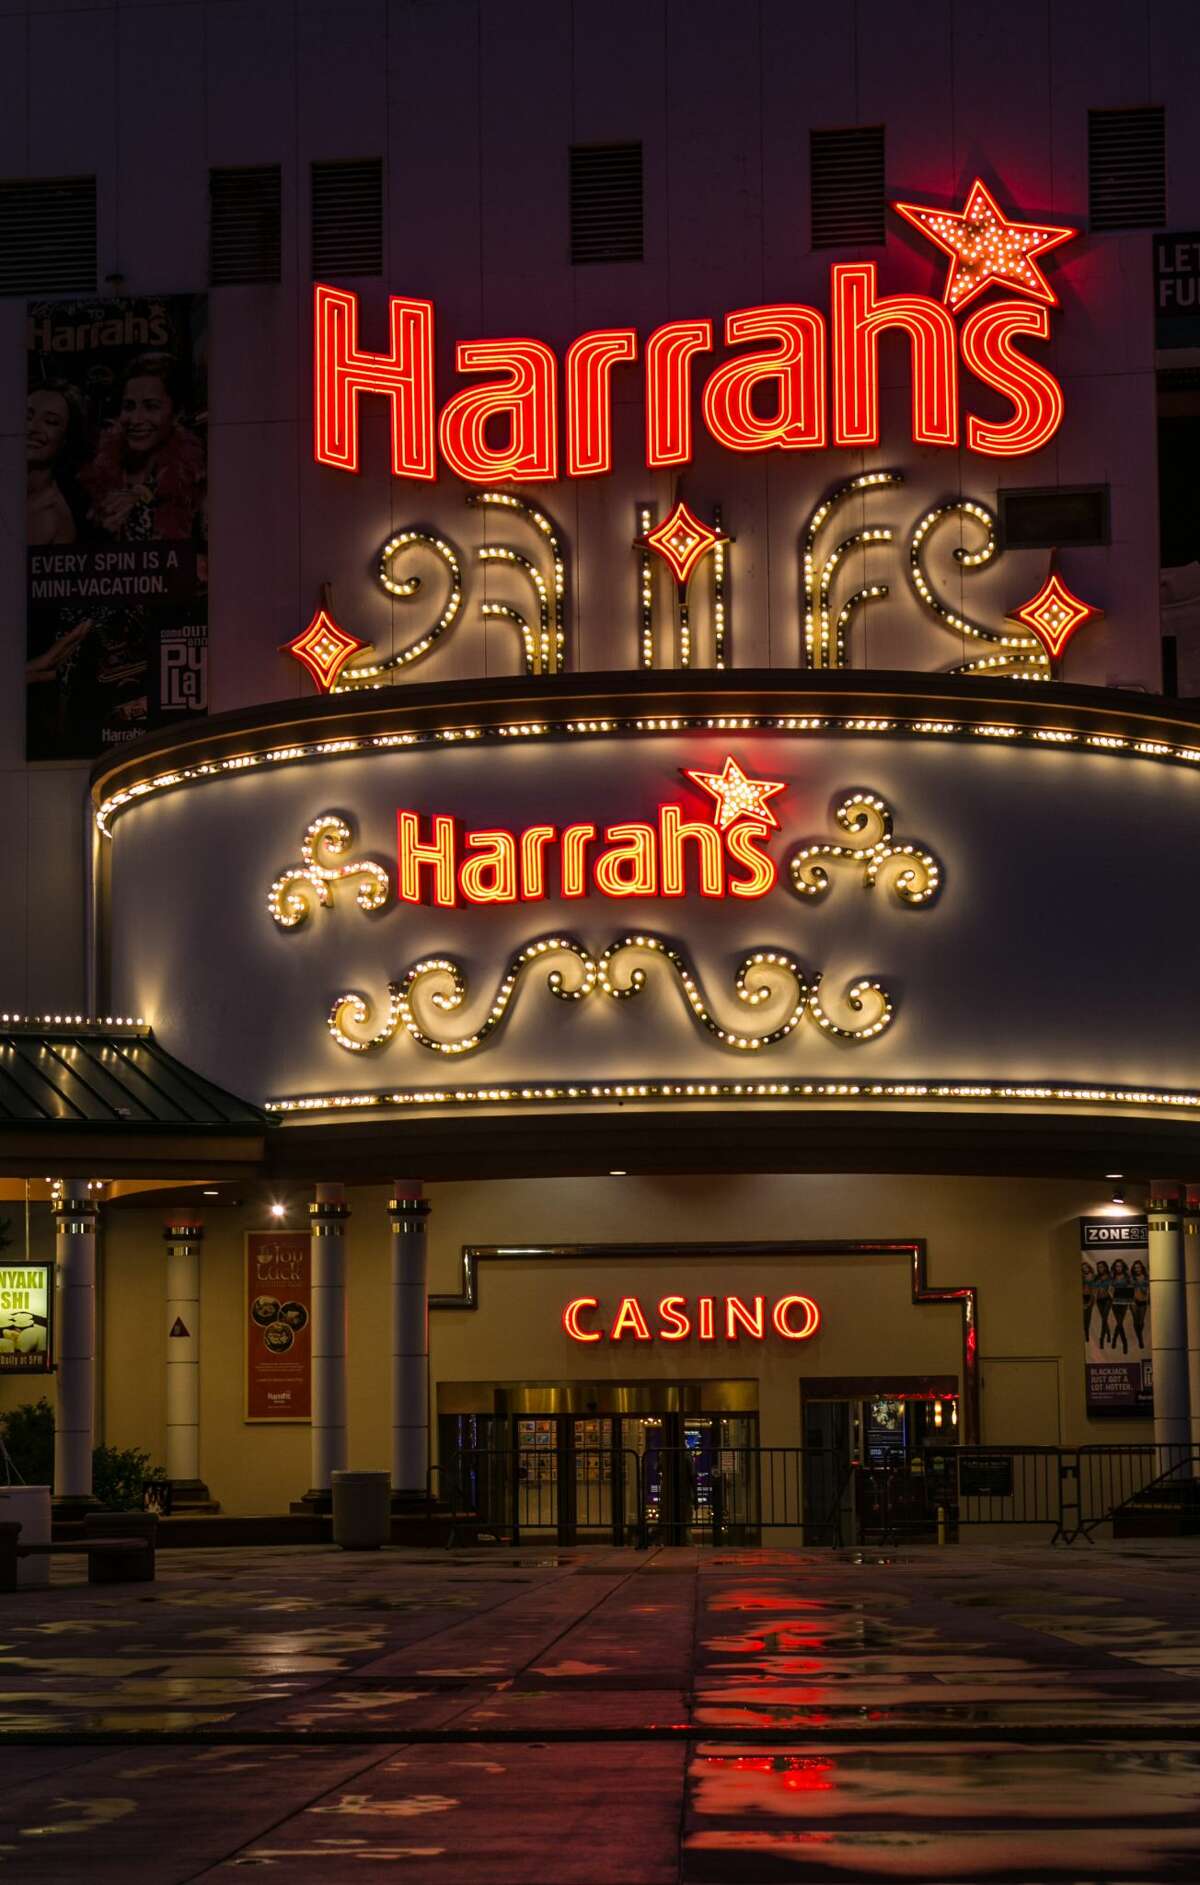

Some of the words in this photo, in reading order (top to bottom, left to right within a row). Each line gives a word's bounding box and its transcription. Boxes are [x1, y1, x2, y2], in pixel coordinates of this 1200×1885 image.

[31, 554, 87, 574] EVERY
[94, 551, 136, 571] SPIN
[143, 550, 160, 569] IS
[166, 549, 178, 569] A
[31, 575, 168, 599] MINI-VACATION.
[1, 1291, 30, 1310] SHI
[564, 1294, 821, 1341] CASINO
